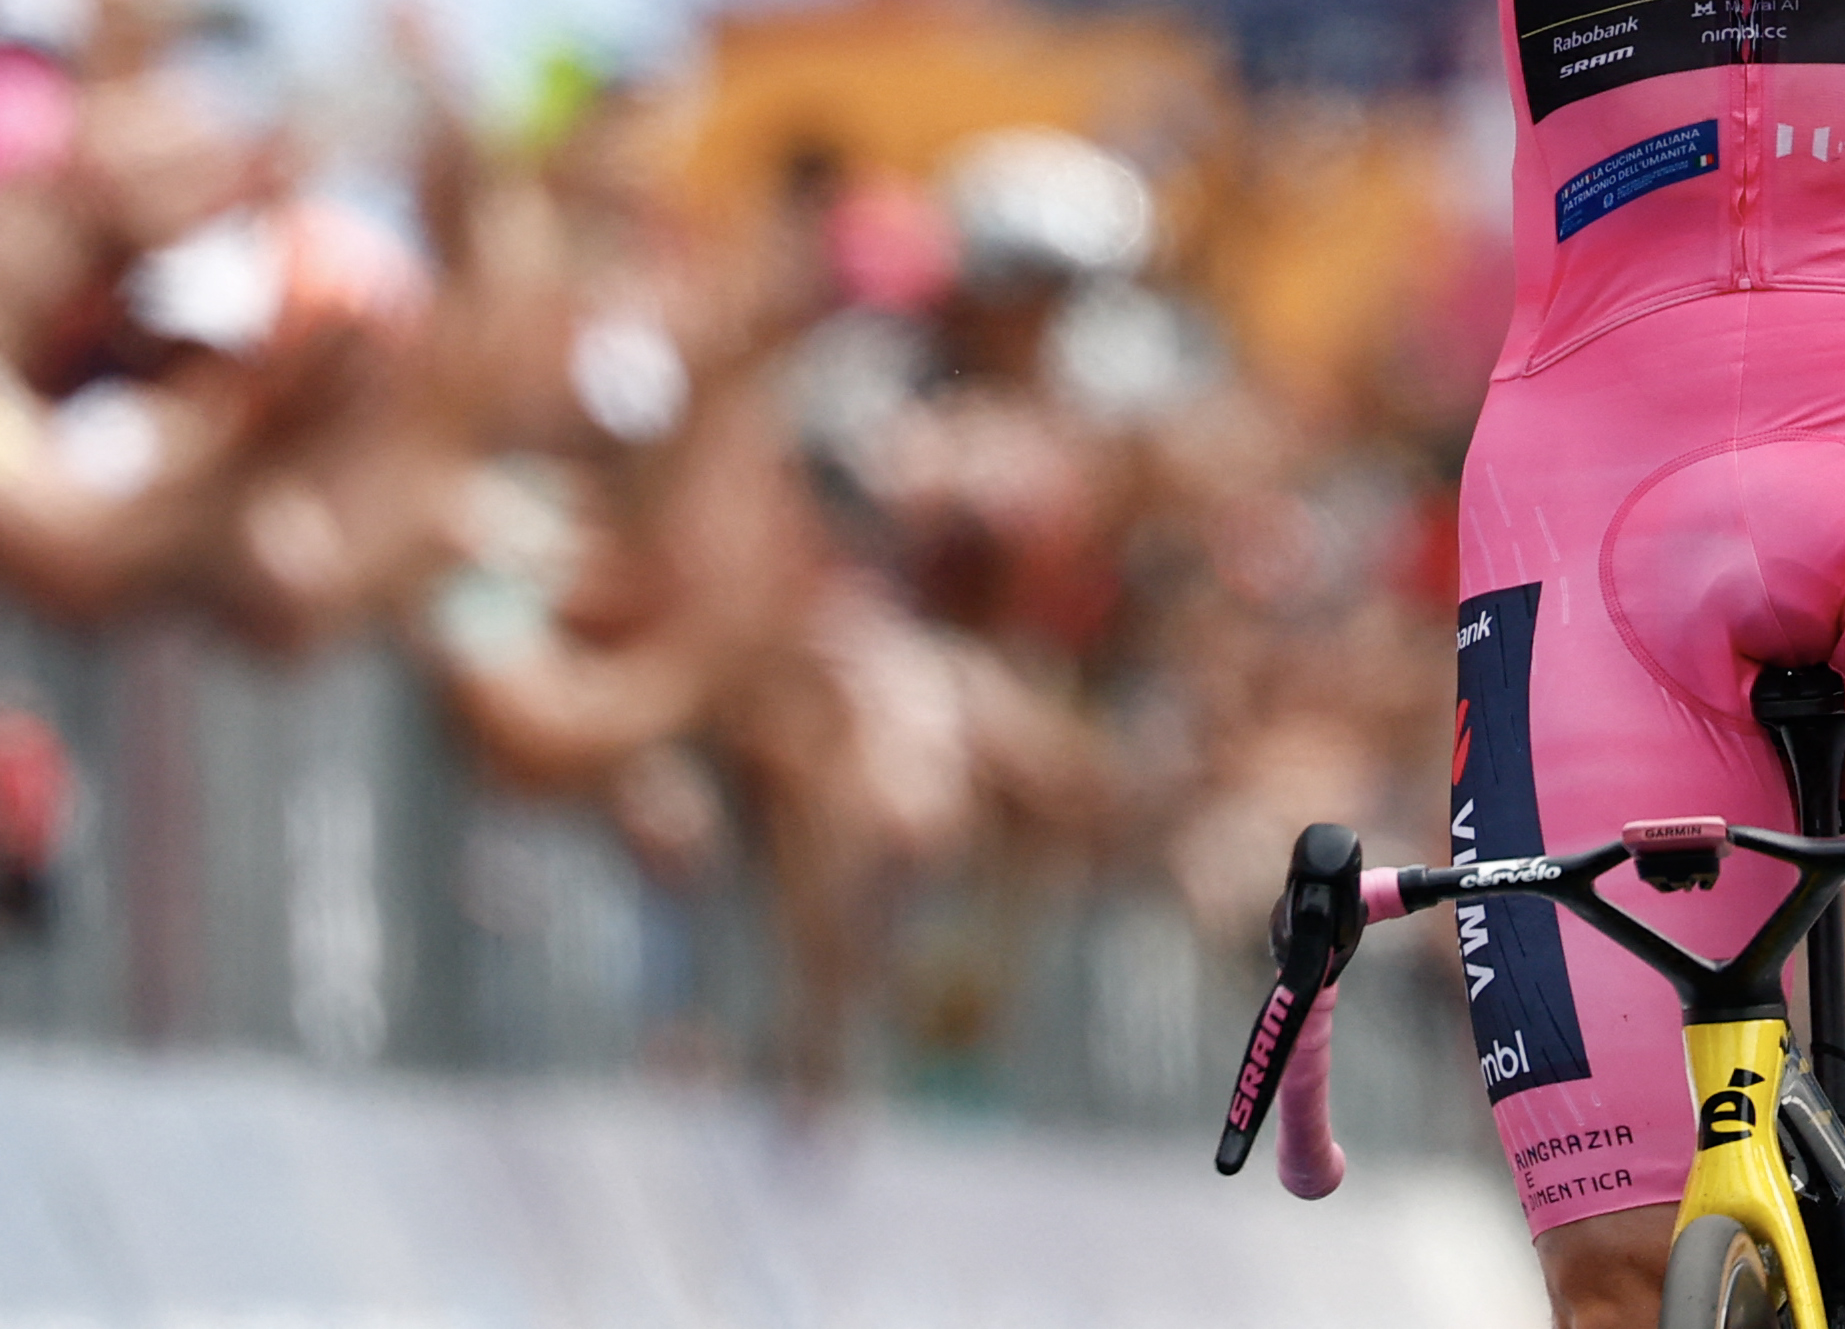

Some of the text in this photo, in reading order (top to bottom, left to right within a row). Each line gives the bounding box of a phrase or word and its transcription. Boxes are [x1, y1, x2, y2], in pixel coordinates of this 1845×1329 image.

[1725, 0, 1776, 13] Mral
[1553, 16, 1639, 54] Rabobank
[1560, 45, 1634, 79] SRAM
[1605, 148, 1643, 172] CUCINA
[1645, 129, 1700, 154] ITALIANA
[1563, 174, 1617, 215] PATRIMONIO
[1645, 825, 1702, 838] GARMIN
[1451, 798, 1495, 1001] VIMA
[1229, 985, 1294, 1132] SRAM
[1481, 1029, 1530, 1086] mbl
[1515, 1125, 1634, 1172] RINGRAZIA
